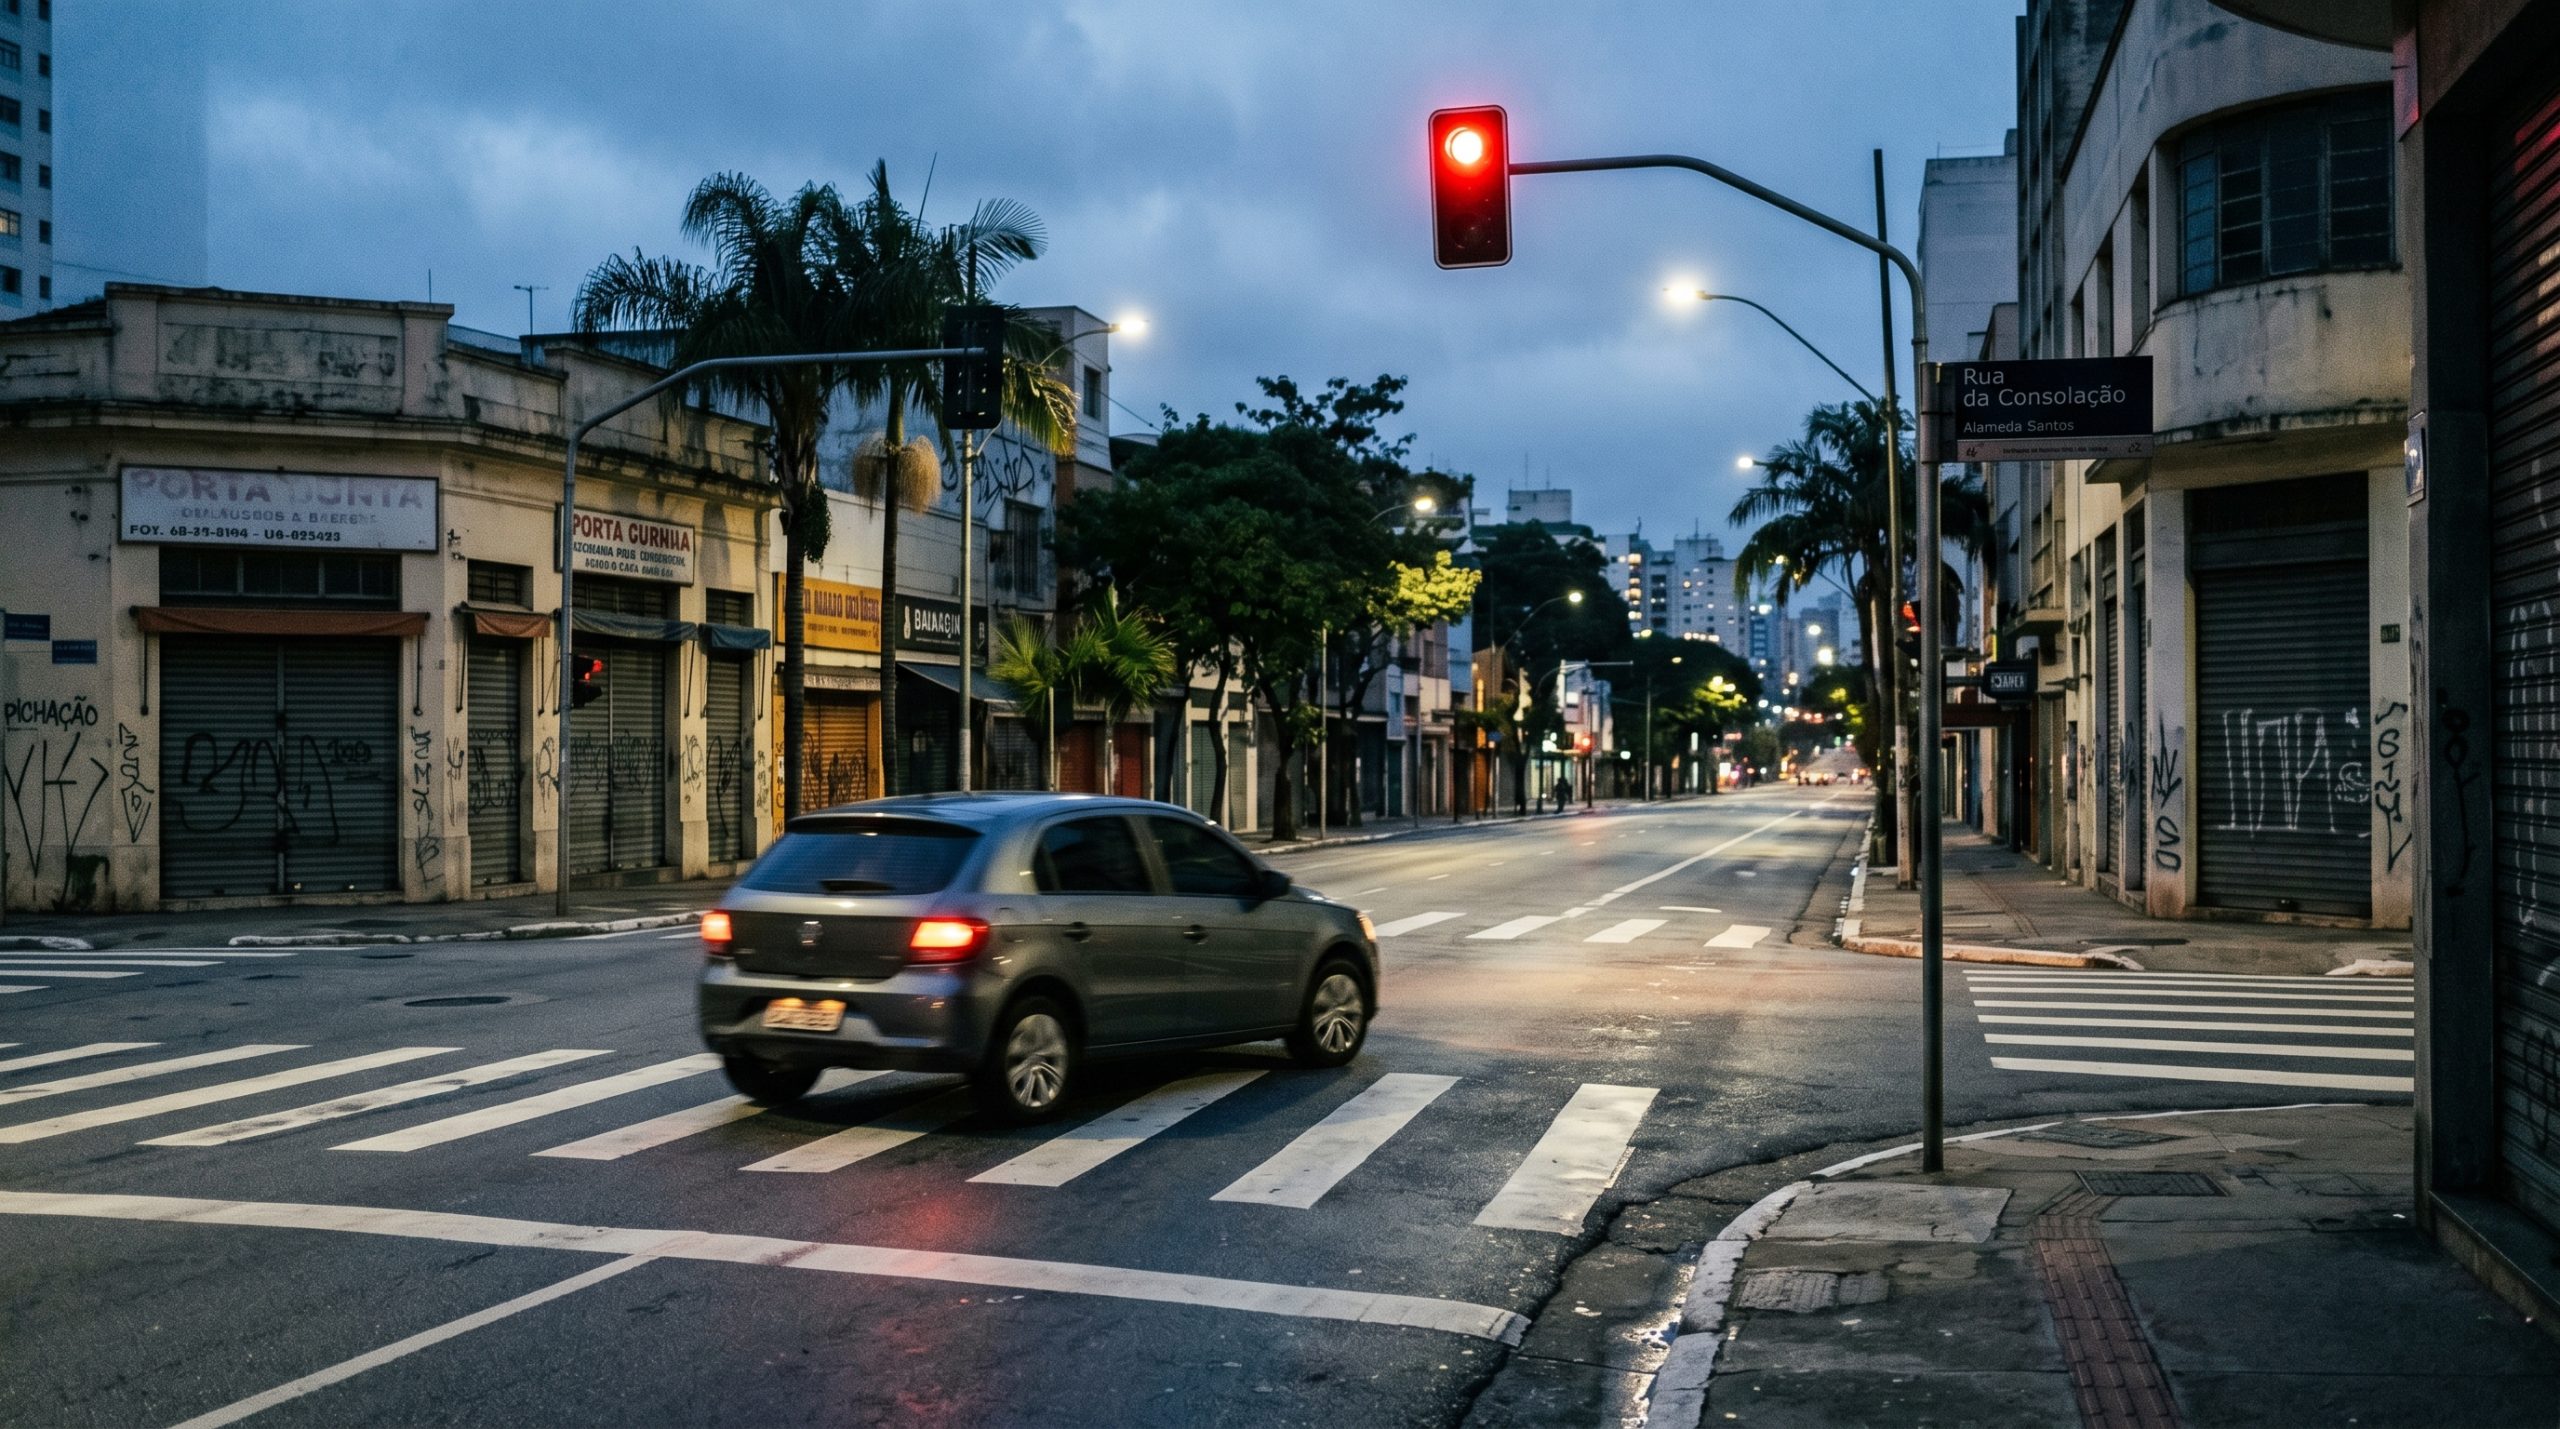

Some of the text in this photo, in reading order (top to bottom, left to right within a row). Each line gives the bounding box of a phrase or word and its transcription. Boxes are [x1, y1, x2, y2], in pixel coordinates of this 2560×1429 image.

[1963, 367, 2004, 385] Rua
[1963, 384, 2126, 408] da Consolação
[1963, 419, 2074, 433] Alameda Santos
[573, 513, 623, 542] PORTA
[4, 696, 98, 731] PICHAÇÃO
